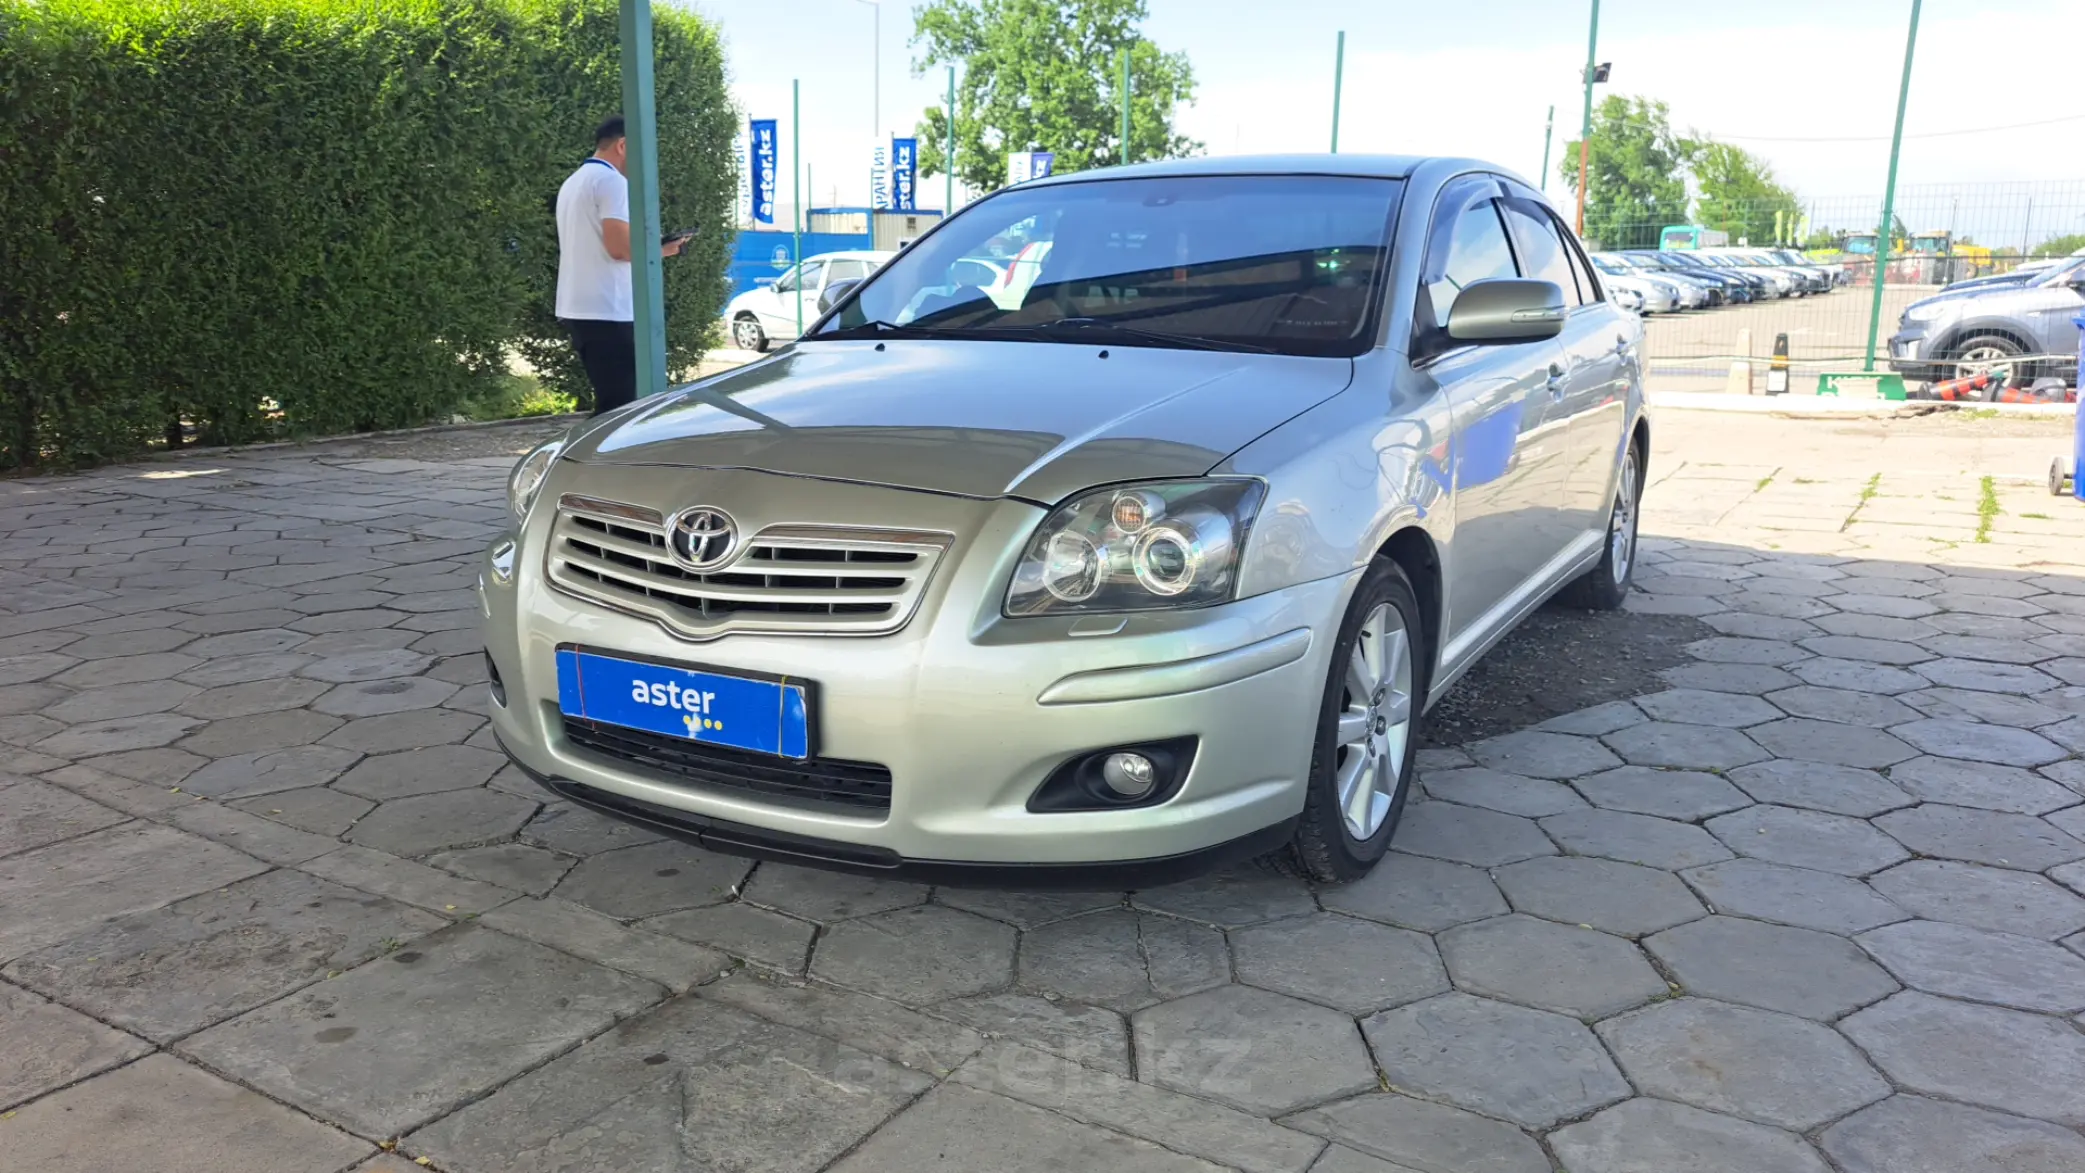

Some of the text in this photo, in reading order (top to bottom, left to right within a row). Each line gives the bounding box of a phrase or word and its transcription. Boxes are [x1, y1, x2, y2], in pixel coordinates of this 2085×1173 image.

[758, 129, 774, 216] aster.kz
[896, 146, 912, 210] ster.kz
[632, 679, 716, 714] aster
